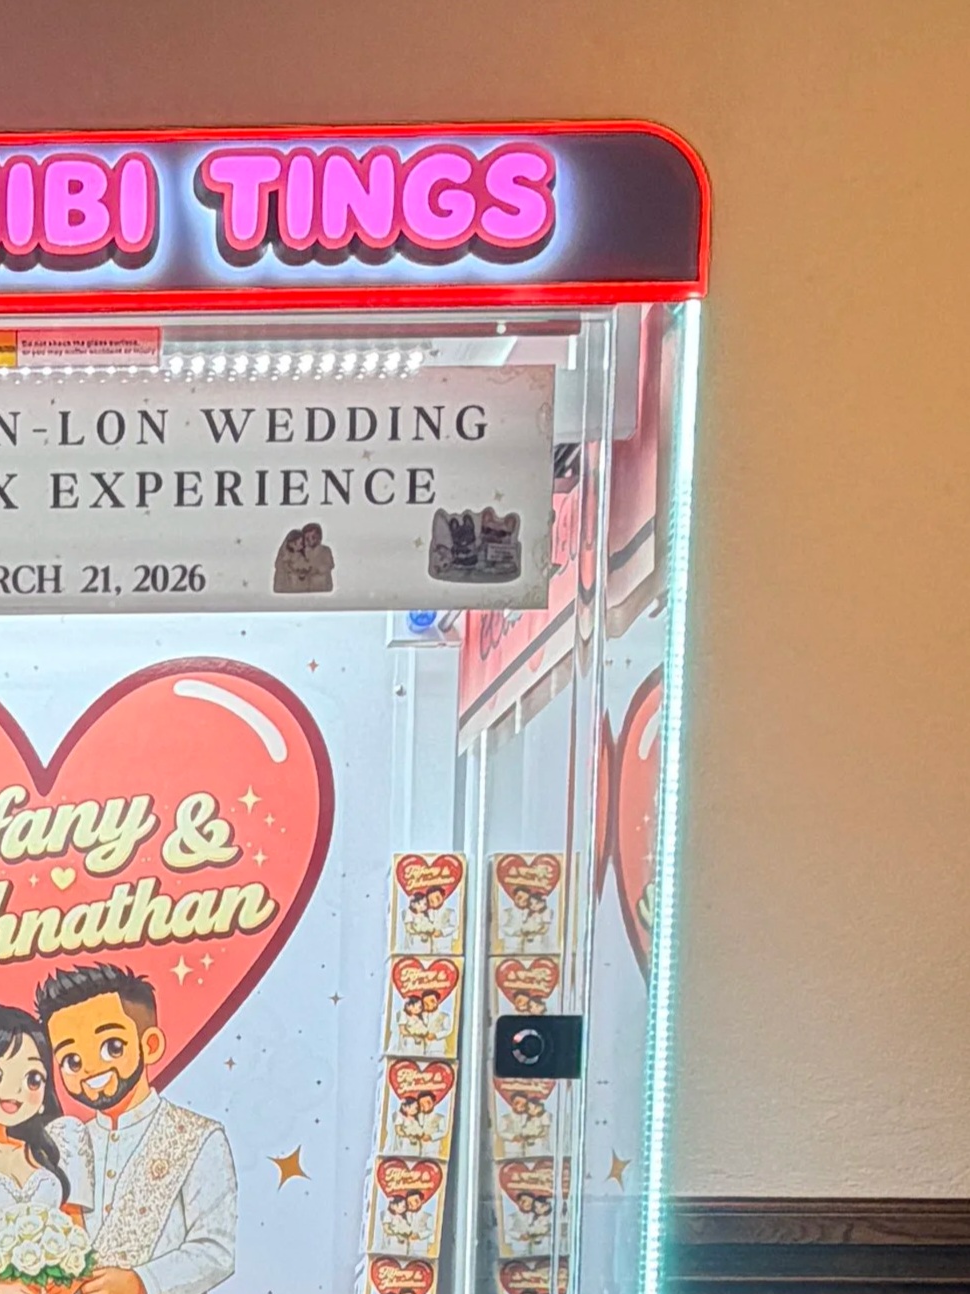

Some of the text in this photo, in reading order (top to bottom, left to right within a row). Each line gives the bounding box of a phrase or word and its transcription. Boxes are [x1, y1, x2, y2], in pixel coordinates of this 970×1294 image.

[200, 142, 557, 254] TINGS
[200, 404, 489, 443] WEDDING
[50, 467, 437, 509] EXPERIENCE
[81, 565, 122, 596] 21,
[132, 563, 206, 593] 2026
[161, 790, 244, 873] &
